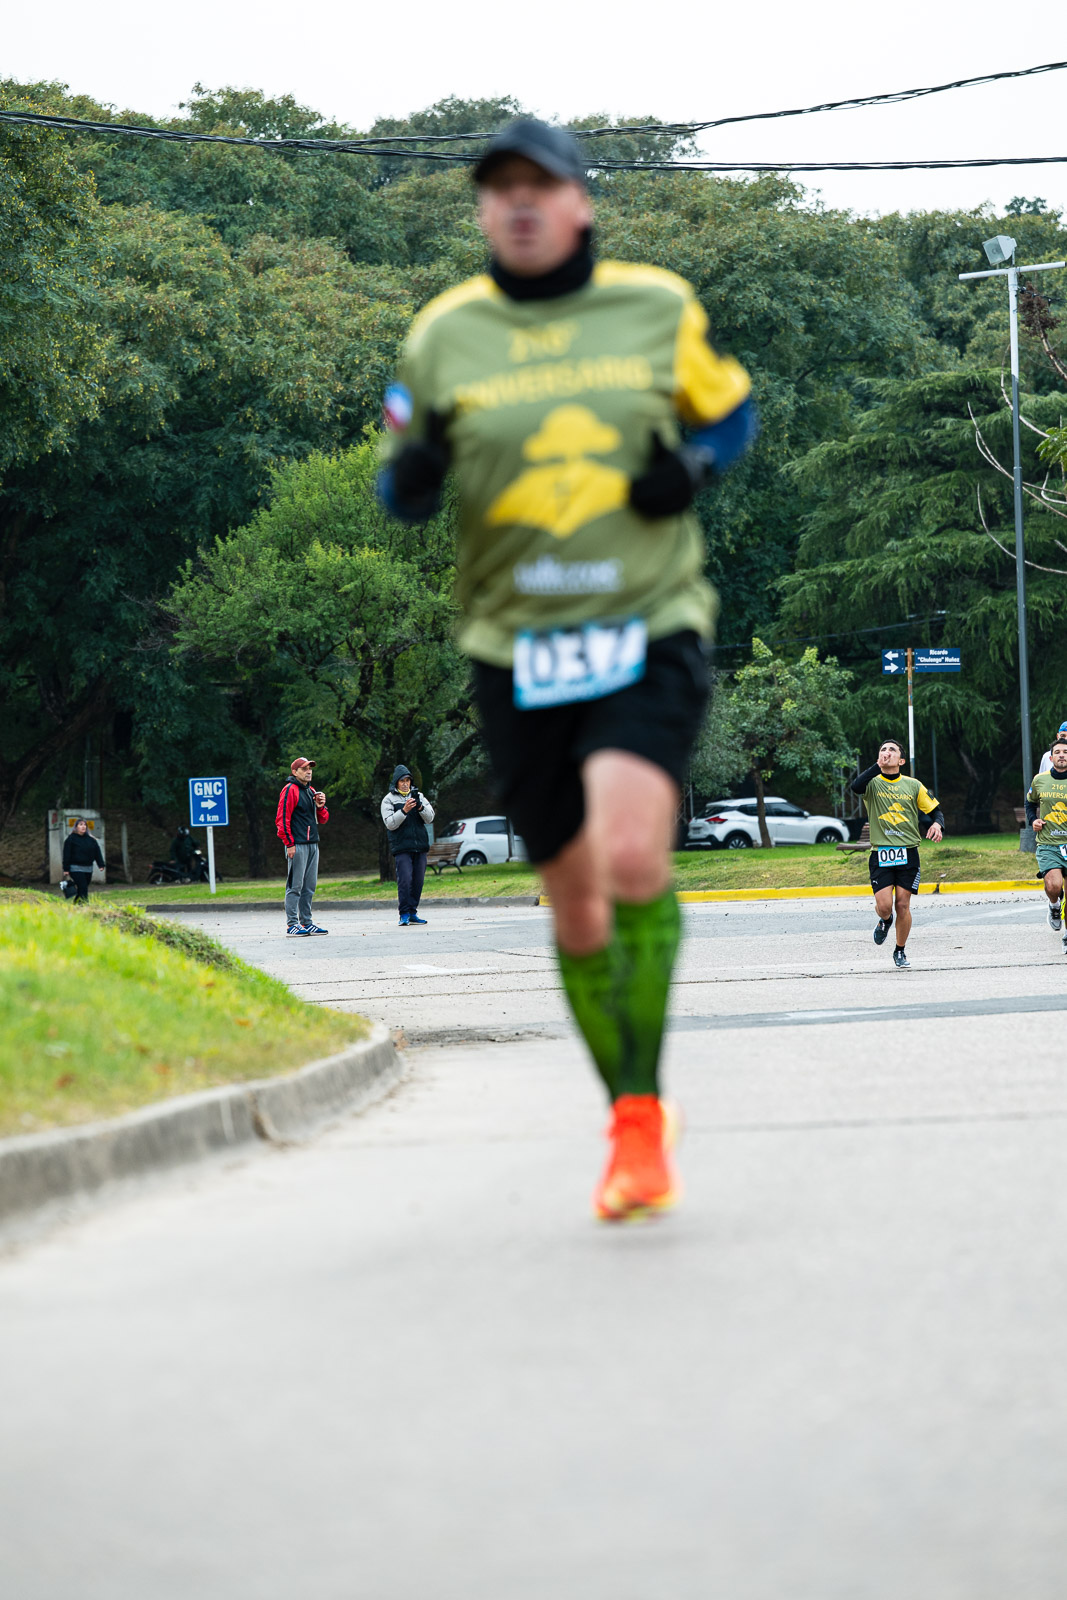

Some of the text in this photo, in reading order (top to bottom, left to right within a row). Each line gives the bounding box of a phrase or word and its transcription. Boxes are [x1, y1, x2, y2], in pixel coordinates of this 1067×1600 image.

[194, 782, 222, 796] GNC
[199, 814, 219, 822] 4 km
[880, 848, 904, 862] 004
